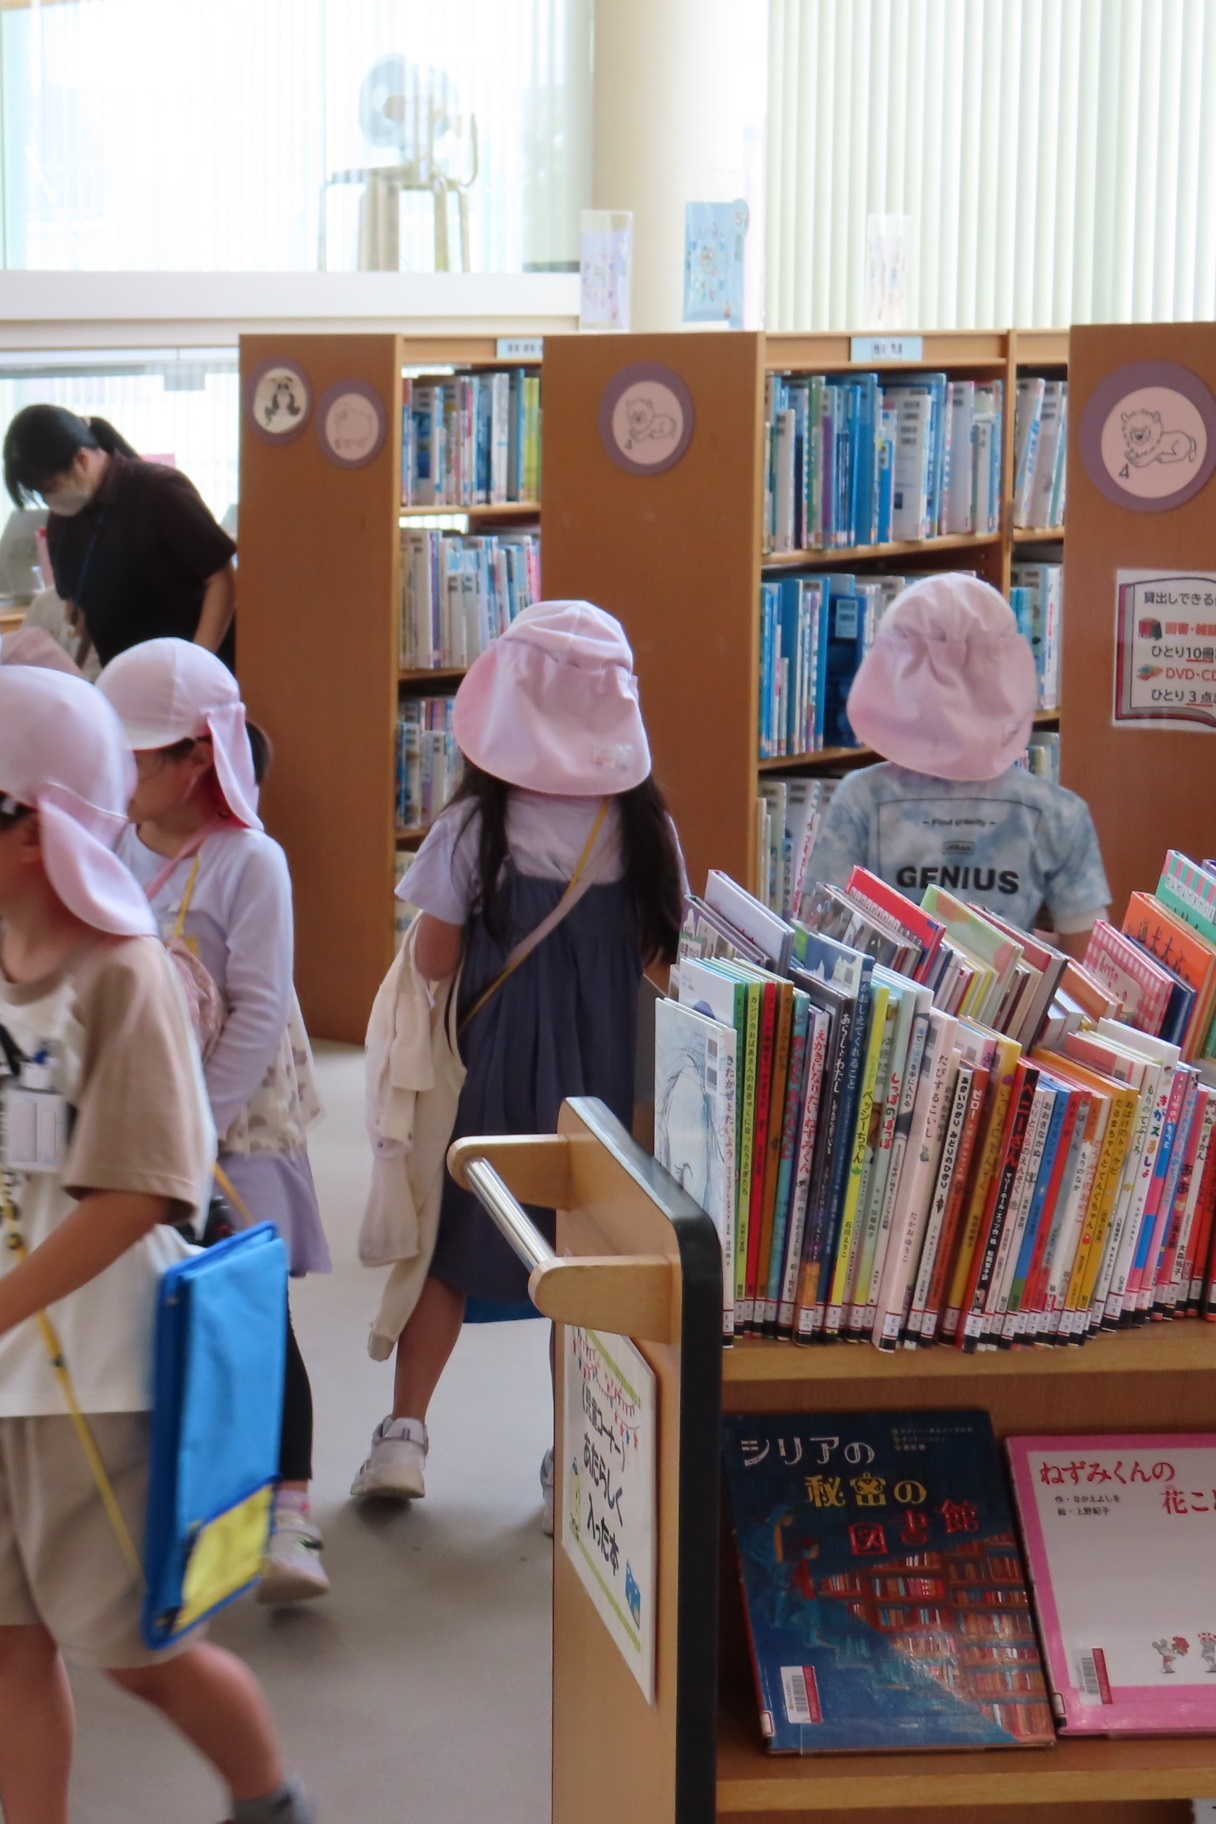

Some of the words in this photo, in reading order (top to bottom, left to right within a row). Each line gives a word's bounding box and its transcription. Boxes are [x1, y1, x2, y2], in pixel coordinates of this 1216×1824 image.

[1118, 463, 1130, 479] 4
[1144, 591, 1216, 606] 貸出しできる
[1151, 645, 1216, 659] ひとり10冊
[896, 866, 1019, 894] GENIUS
[925, 1055, 948, 1138] たびするこいし
[740, 1435, 875, 1467] シリアの
[583, 1431, 623, 1527] あたらしく
[1039, 1460, 1176, 1486] ねずみくんの
[804, 1472, 927, 1508] 秘密の
[1160, 1488, 1216, 1516] 花こ
[587, 1492, 620, 1577] 入った本
[848, 1498, 980, 1556] 図書館
